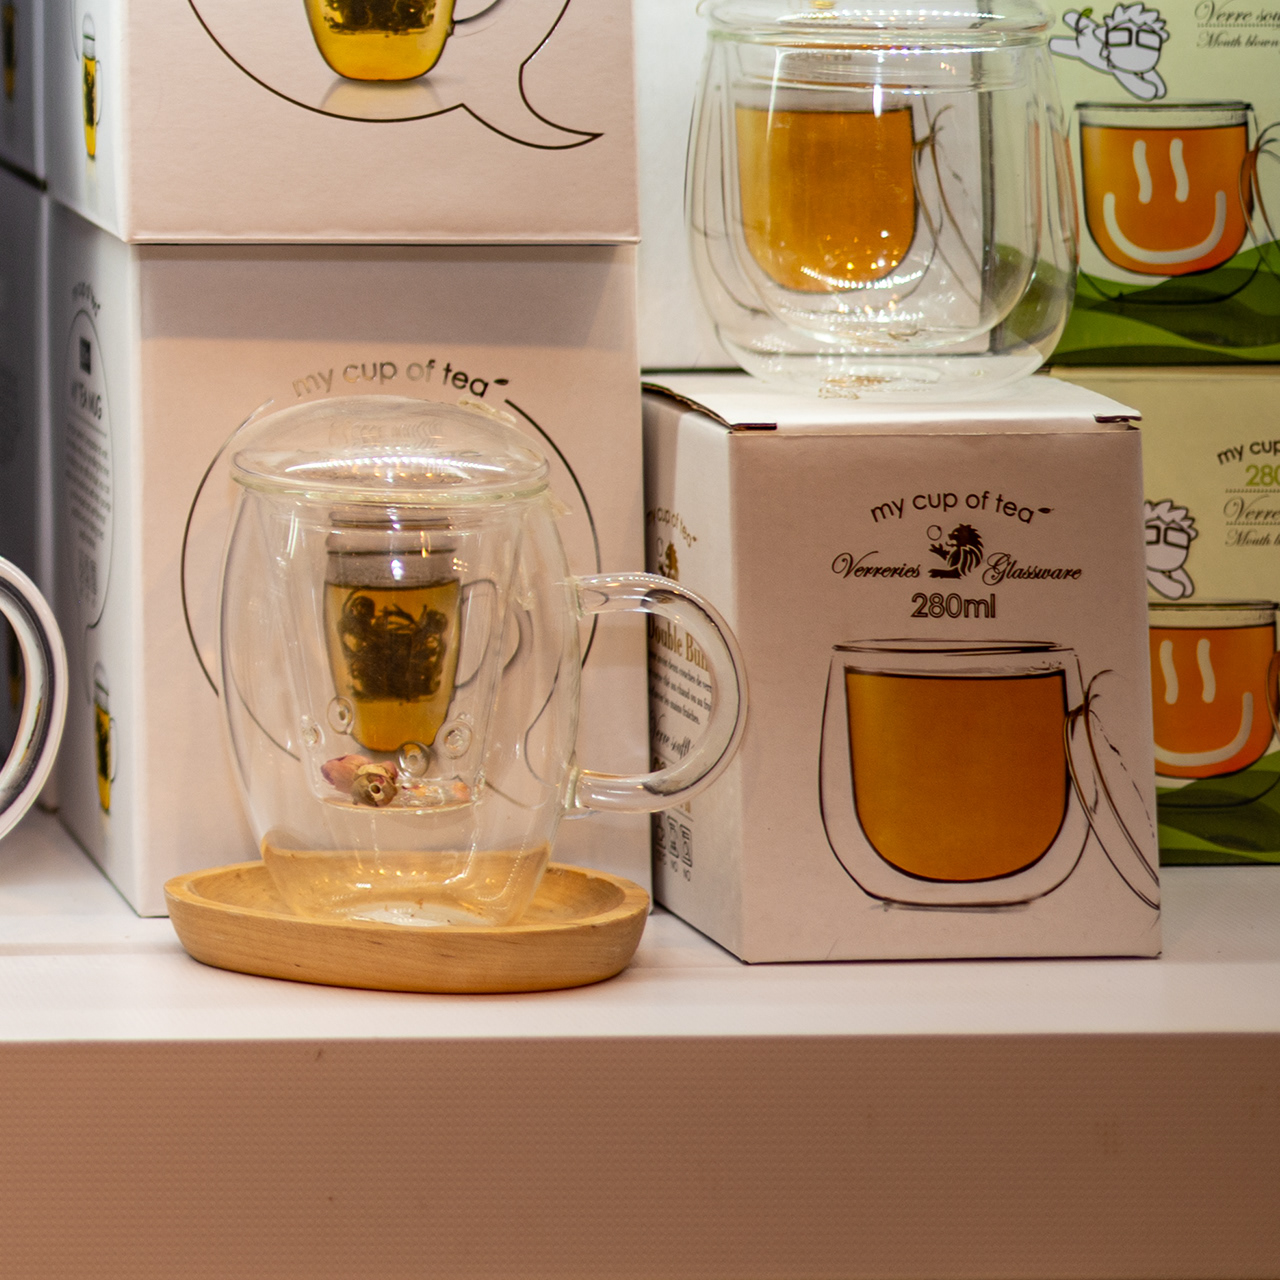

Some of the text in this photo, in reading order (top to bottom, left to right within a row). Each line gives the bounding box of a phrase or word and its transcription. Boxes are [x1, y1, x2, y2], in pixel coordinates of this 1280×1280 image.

[291, 359, 490, 399] my cup of tea
[1217, 444, 1244, 465] my
[871, 491, 1035, 524] my cup of tea
[831, 550, 1082, 586] Verreries Glassware
[911, 592, 996, 619] 280ml
